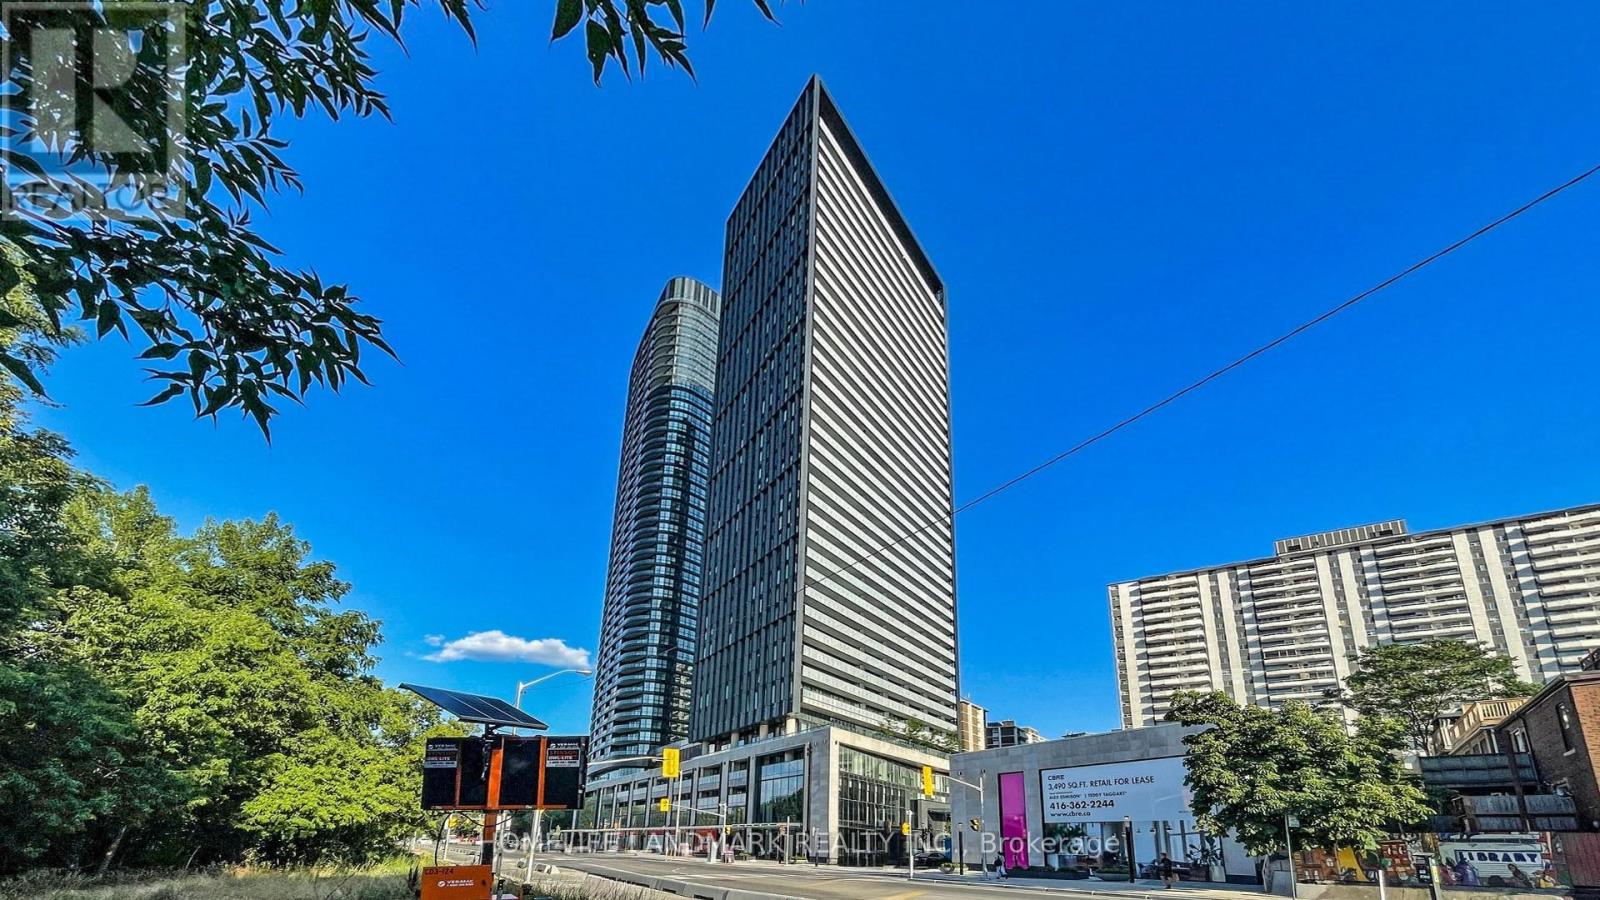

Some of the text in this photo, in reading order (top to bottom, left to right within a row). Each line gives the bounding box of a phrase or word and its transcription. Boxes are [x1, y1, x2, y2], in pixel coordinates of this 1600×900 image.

[1048, 782, 1066, 791] 3,490
[1089, 779, 1113, 788] RETAIL
[1114, 777, 1130, 786] FOR
[1131, 775, 1155, 785] LEASE
[1050, 800, 1115, 810] 416-362-2244
[1458, 851, 1538, 863] LIBRARY
